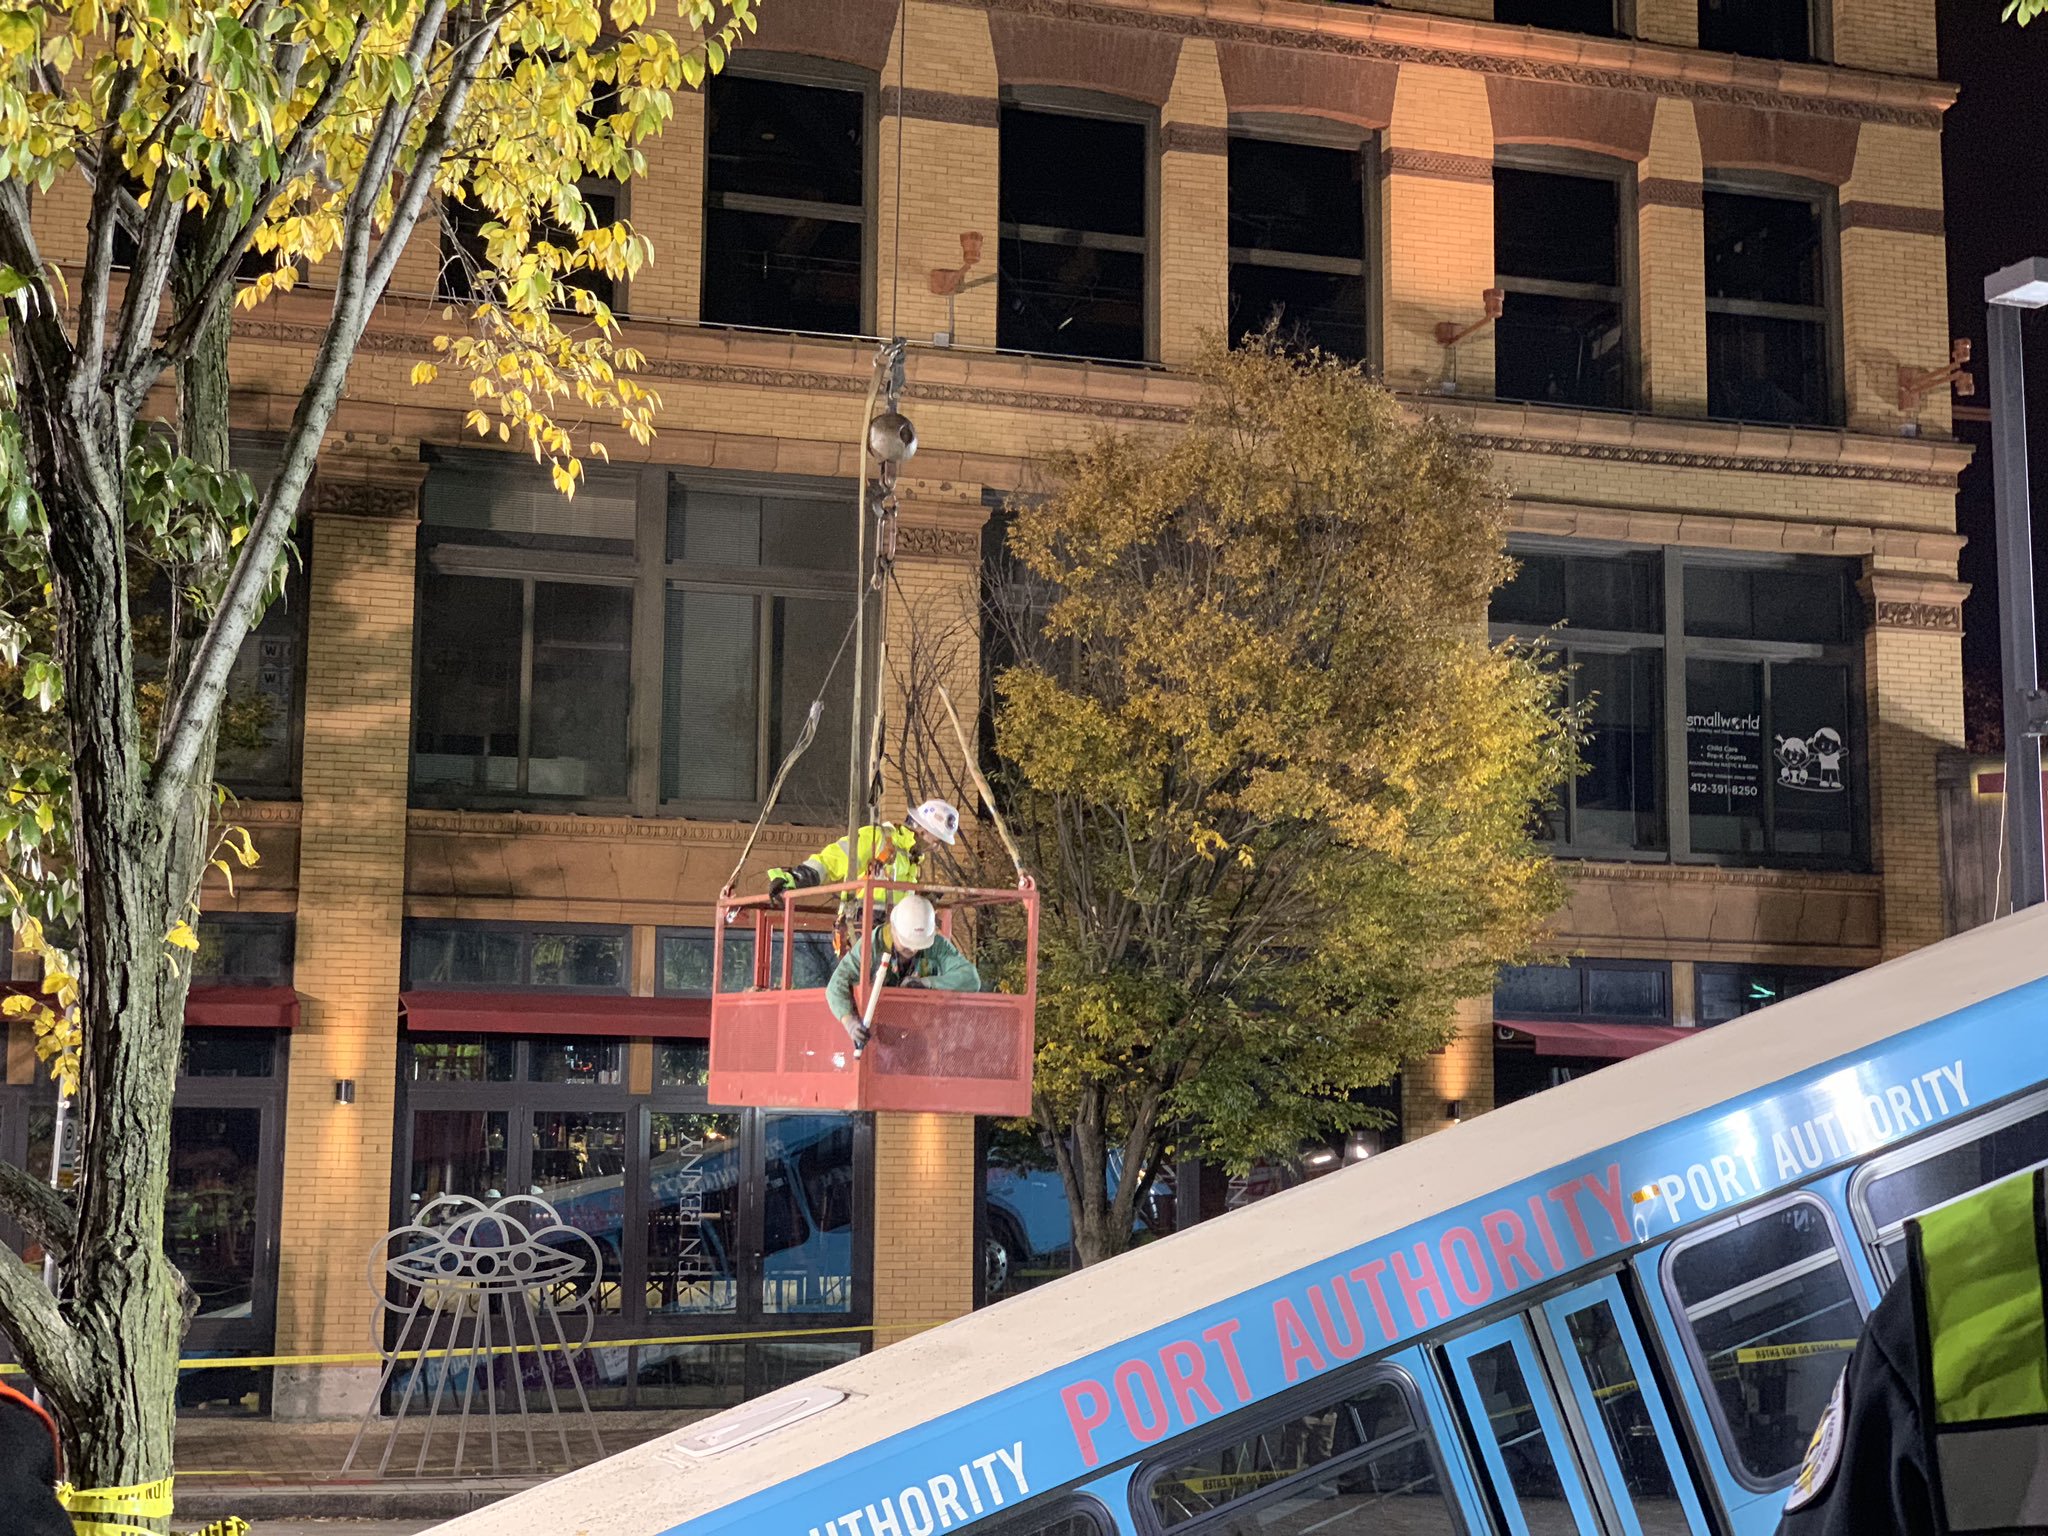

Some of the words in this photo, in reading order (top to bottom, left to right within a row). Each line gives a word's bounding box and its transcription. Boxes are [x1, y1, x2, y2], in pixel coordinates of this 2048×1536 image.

[1686, 711, 1760, 730] smallworld
[1690, 782, 1758, 797] 412-391-8250
[679, 1131, 704, 1228] PENNY
[1658, 1146, 1762, 1223] PORT
[1060, 1318, 1253, 1467] PORT
[1272, 1163, 1634, 1383] AUTHORITY
[809, 1441, 1030, 1536] THORITY
